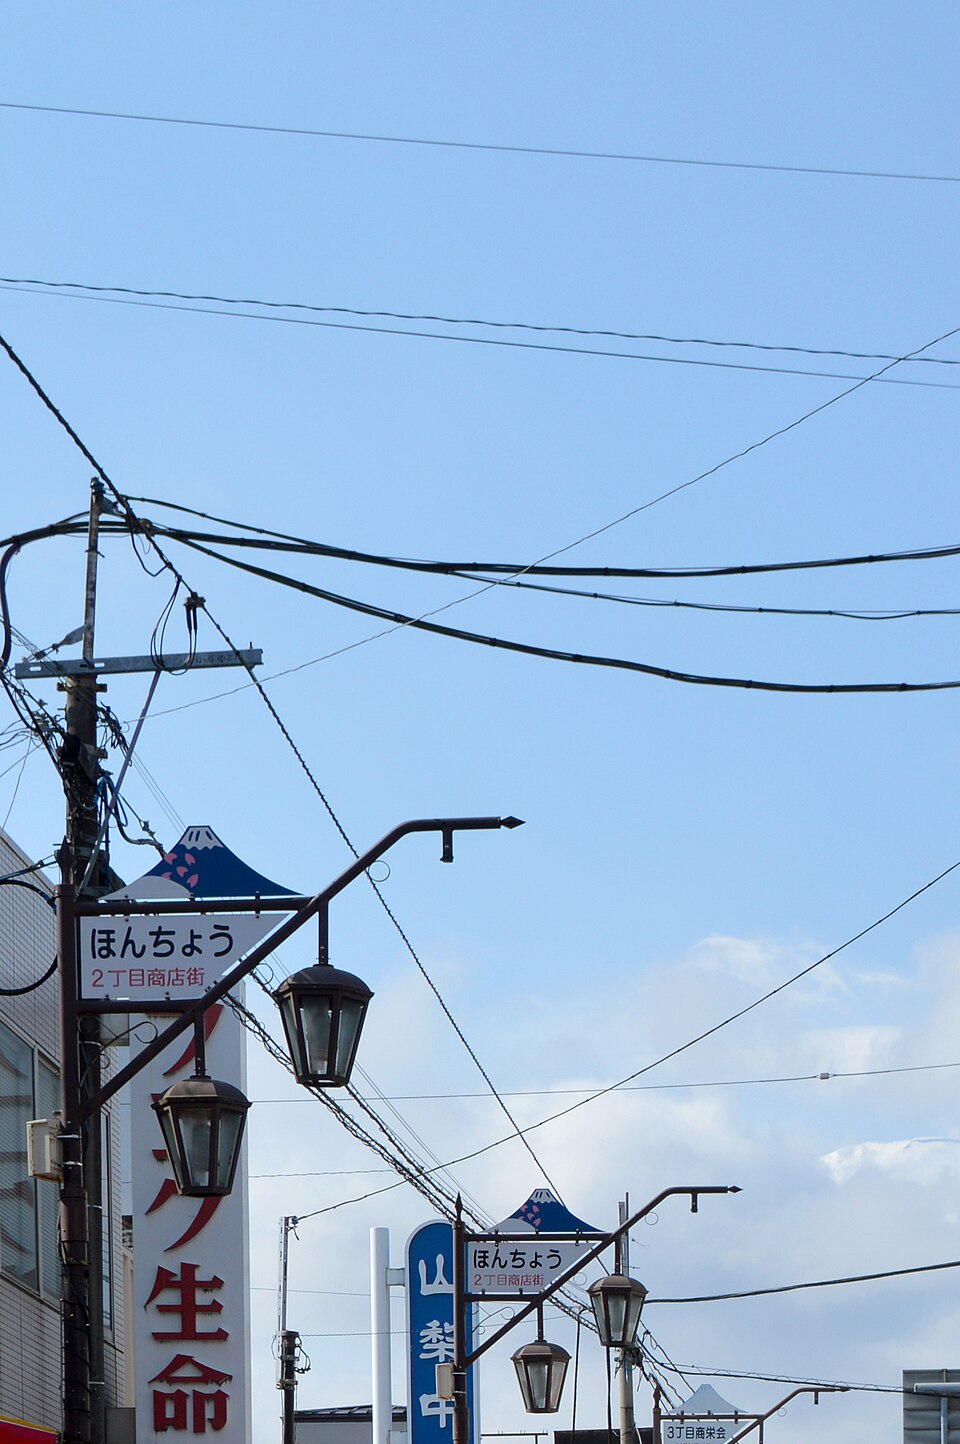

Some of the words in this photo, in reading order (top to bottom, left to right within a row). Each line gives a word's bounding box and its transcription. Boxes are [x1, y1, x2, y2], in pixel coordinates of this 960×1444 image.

[91, 924, 233, 959] ほんちょう
[91, 968, 205, 988] 2丁目商店街
[473, 1249, 562, 1269] ほんちょう
[473, 1274, 545, 1286] 2丁目商店街
[667, 1426, 726, 1440] 3丁目商栄会
